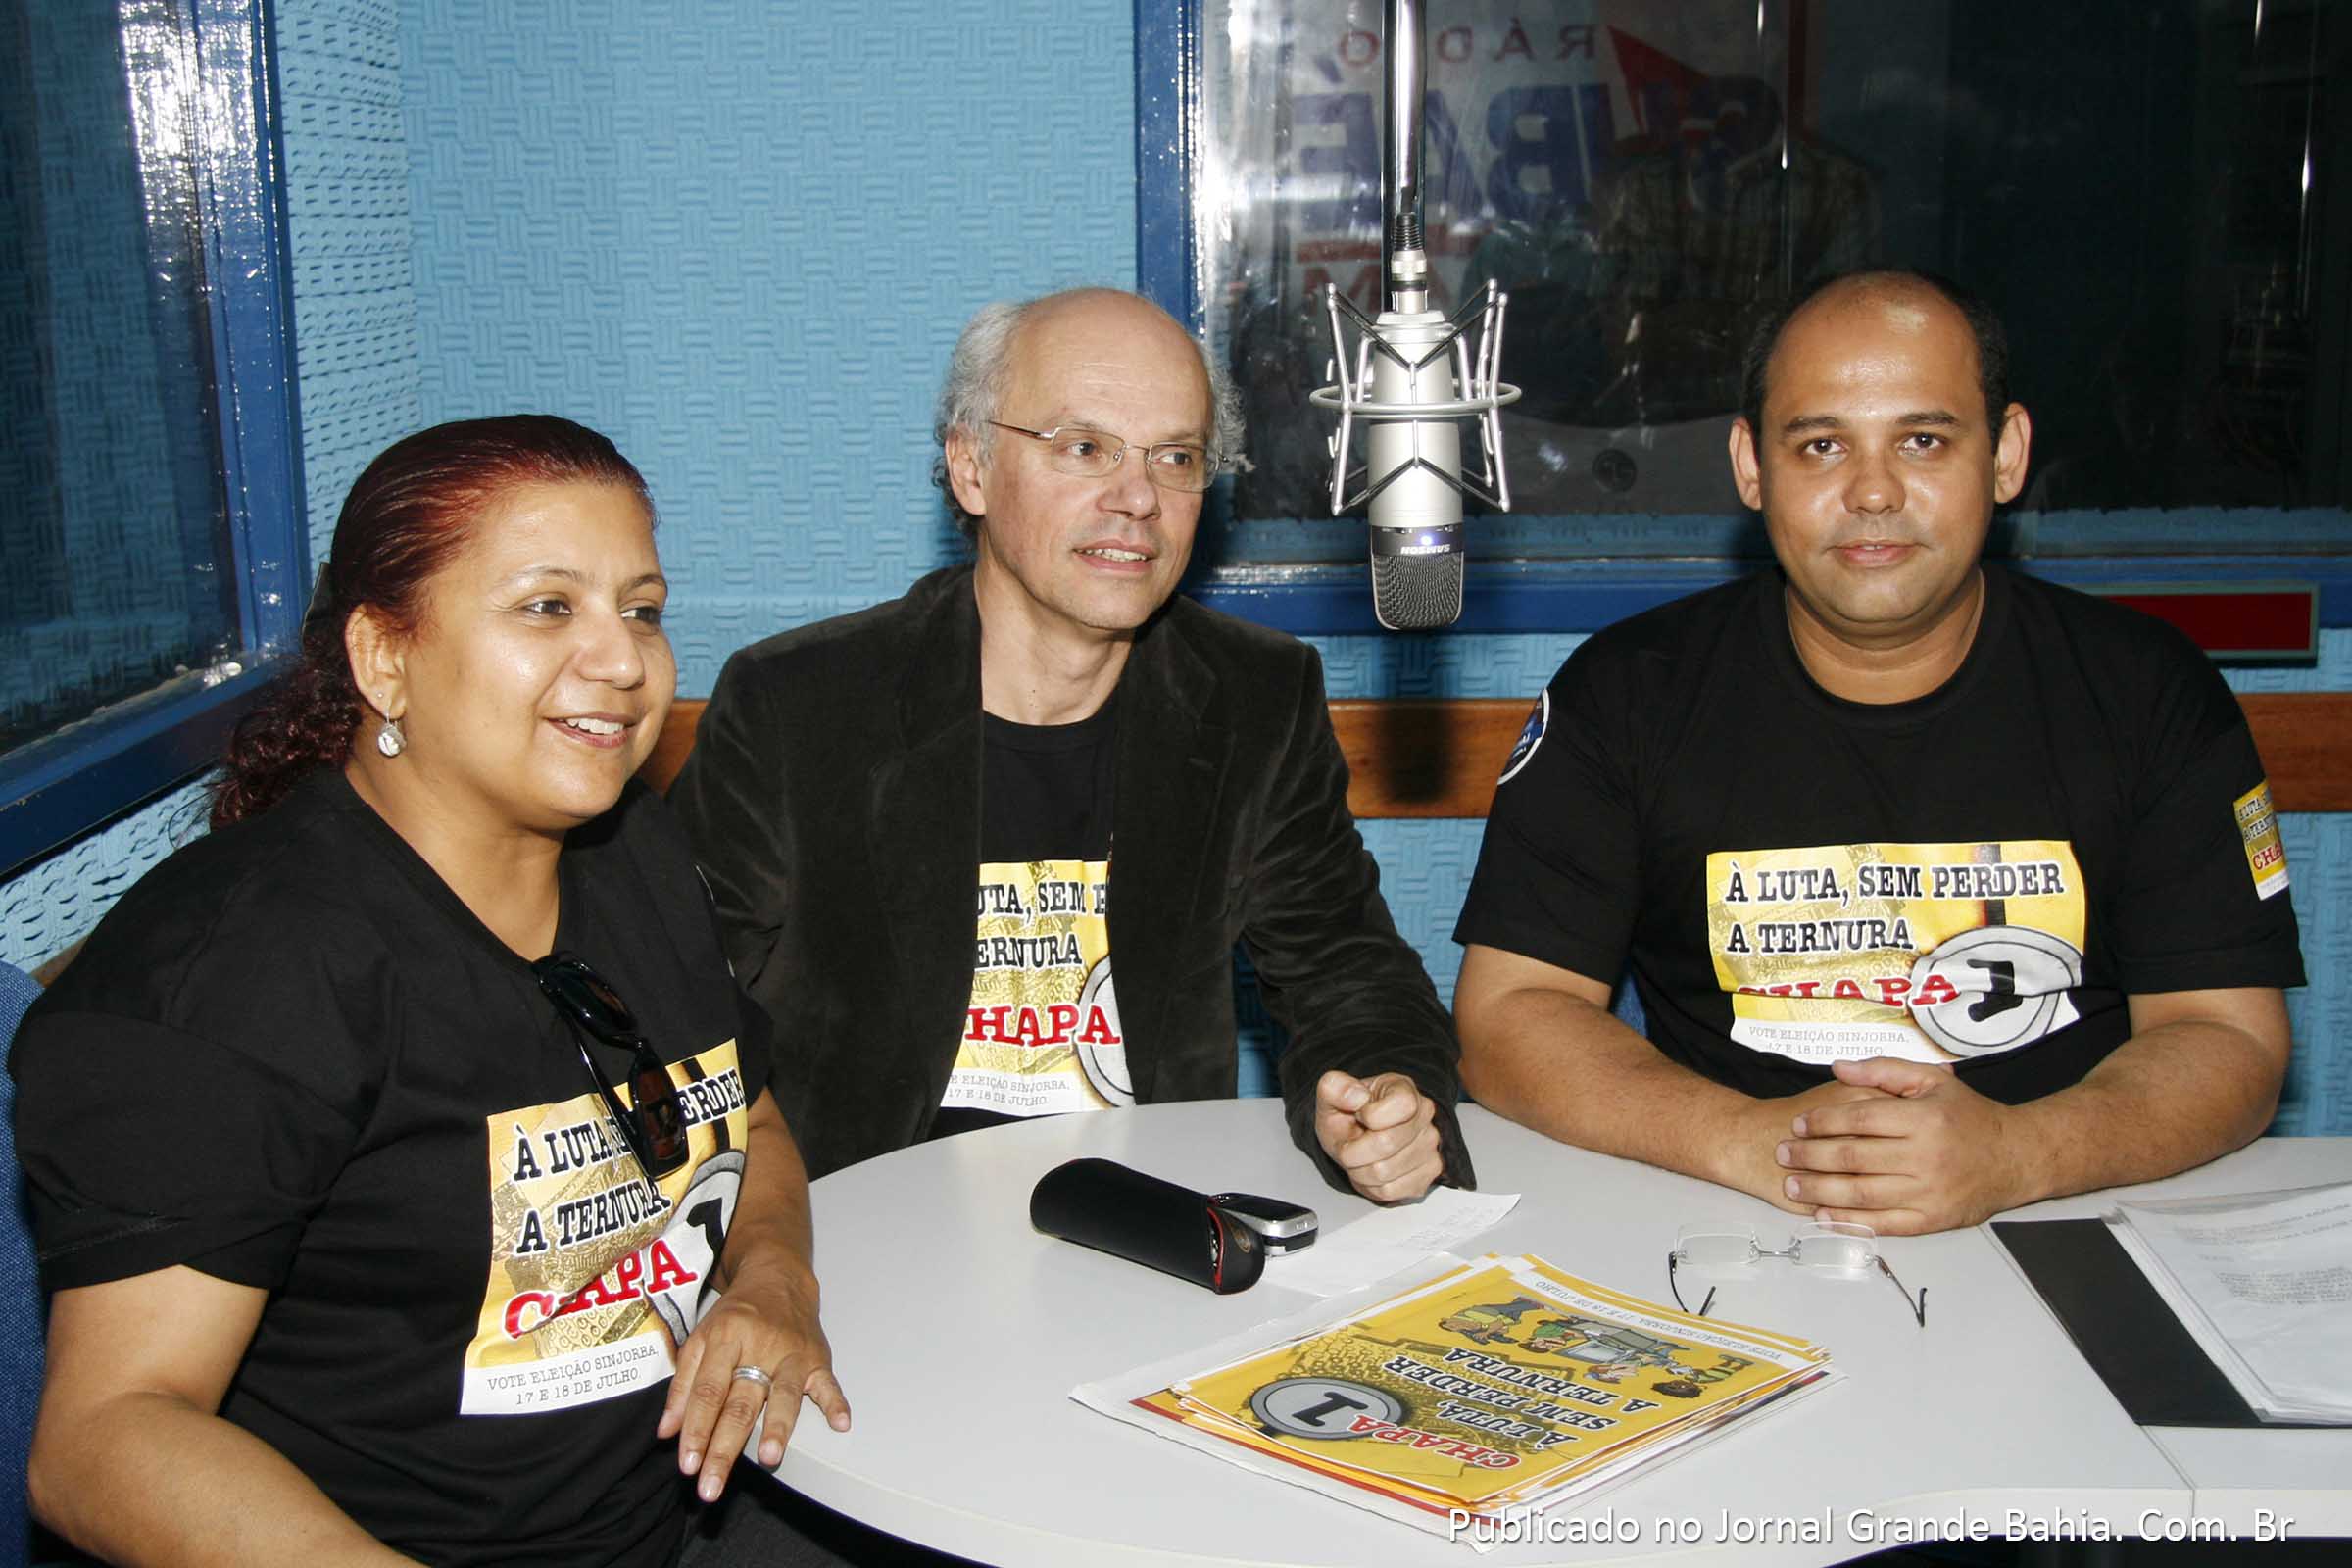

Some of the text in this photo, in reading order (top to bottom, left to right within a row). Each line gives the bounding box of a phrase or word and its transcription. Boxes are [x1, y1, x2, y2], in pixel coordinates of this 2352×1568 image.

[978, 883, 1031, 923] UTA,
[1038, 882, 1087, 913] SEM
[1725, 861, 2064, 906] À LUTA, SEM PERDER
[975, 934, 1082, 968] ERNURA
[1727, 919, 1914, 953] A TERNURA
[1737, 974, 1961, 1006] APA
[964, 1004, 1120, 1047] HAPA
[1749, 1027, 1777, 1038] VOTE
[1815, 1045, 1834, 1055] DE
[672, 1069, 746, 1126] ERDER
[514, 1124, 542, 1181] À
[516, 1179, 672, 1253] A TERNURA
[505, 1239, 699, 1339] CAPA
[487, 1375, 527, 1390] VOTE
[531, 1360, 592, 1383] ELEIÇÃO
[516, 1368, 639, 1405] 17 E 18 DE JULHO
[1384, 1356, 1618, 1430] SEM PERDER
[1444, 1348, 1660, 1412] A TERNURA
[1292, 1392, 1521, 1469] CHAPA 1
[1437, 1400, 1578, 1448] À LUTA,
